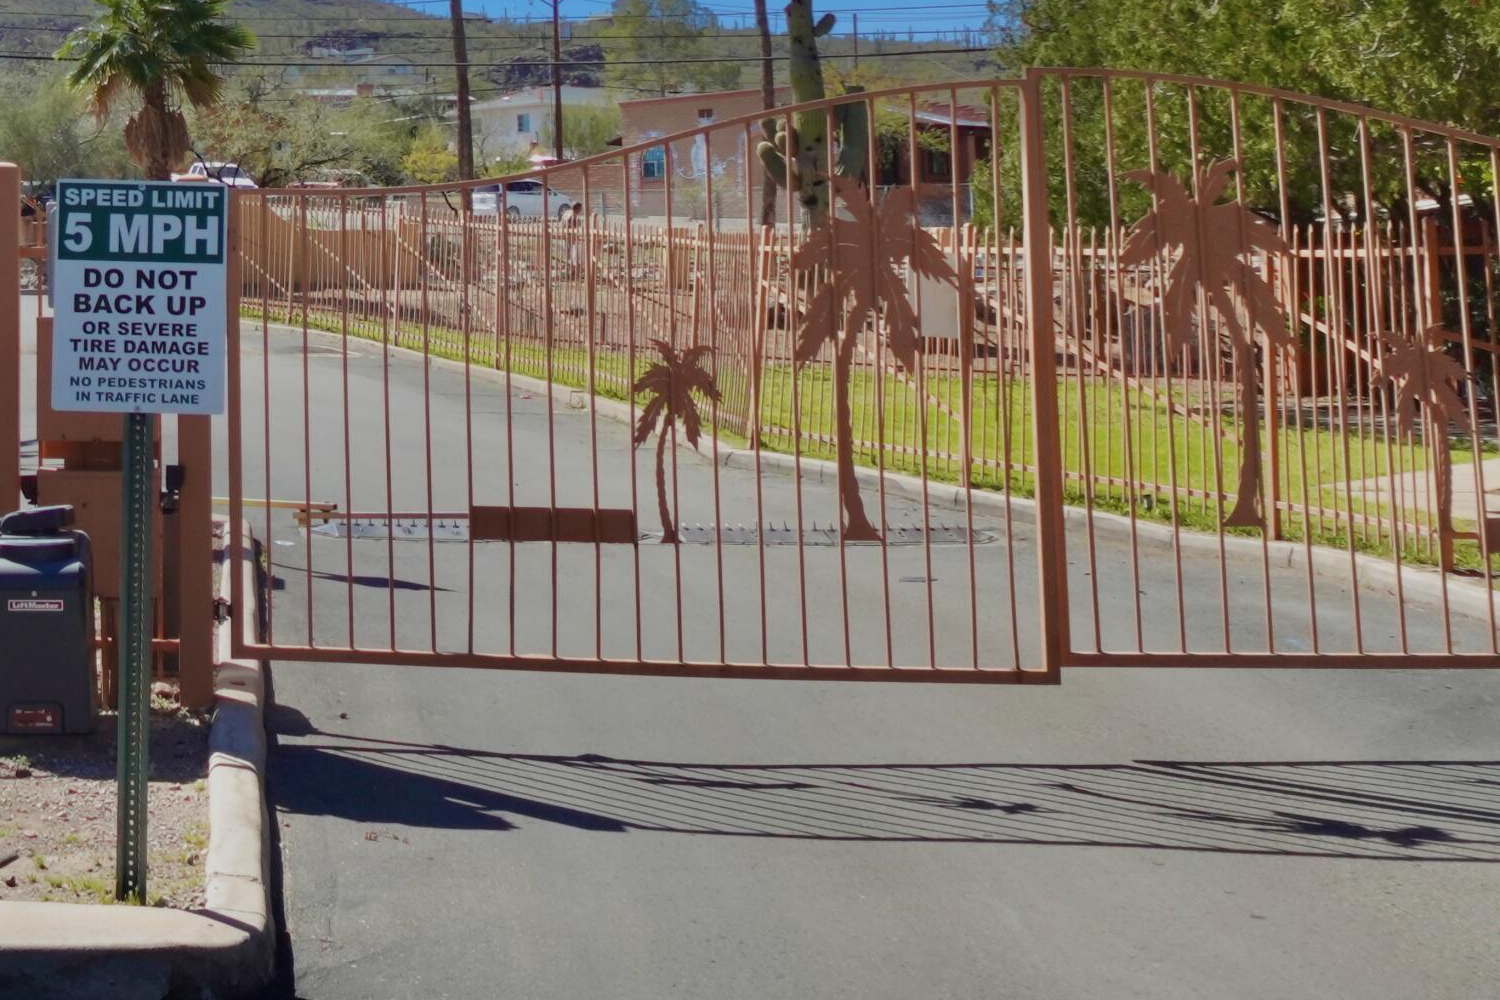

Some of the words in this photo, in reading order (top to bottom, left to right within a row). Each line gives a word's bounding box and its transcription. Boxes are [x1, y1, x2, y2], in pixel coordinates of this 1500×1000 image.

[65, 188, 143, 207] SPEED
[152, 191, 219, 209] LIMIT
[64, 212, 93, 252] 5
[109, 213, 219, 255] MPH
[84, 268, 124, 288] DO
[136, 270, 197, 290] NOT
[73, 294, 155, 315] BACK
[167, 296, 206, 316] UP
[82, 321, 110, 335] OR
[118, 322, 197, 337] SEVERE
[70, 338, 115, 353] TIRE
[124, 340, 209, 355] DAMAGE
[79, 357, 121, 371] MAY
[128, 358, 200, 373] OCCUR
[70, 377, 91, 387] NO
[97, 377, 205, 390] PEDESTRIANS
[76, 391, 91, 402] IN
[97, 392, 157, 403] TRAFFIC
[161, 394, 199, 405] LANE
